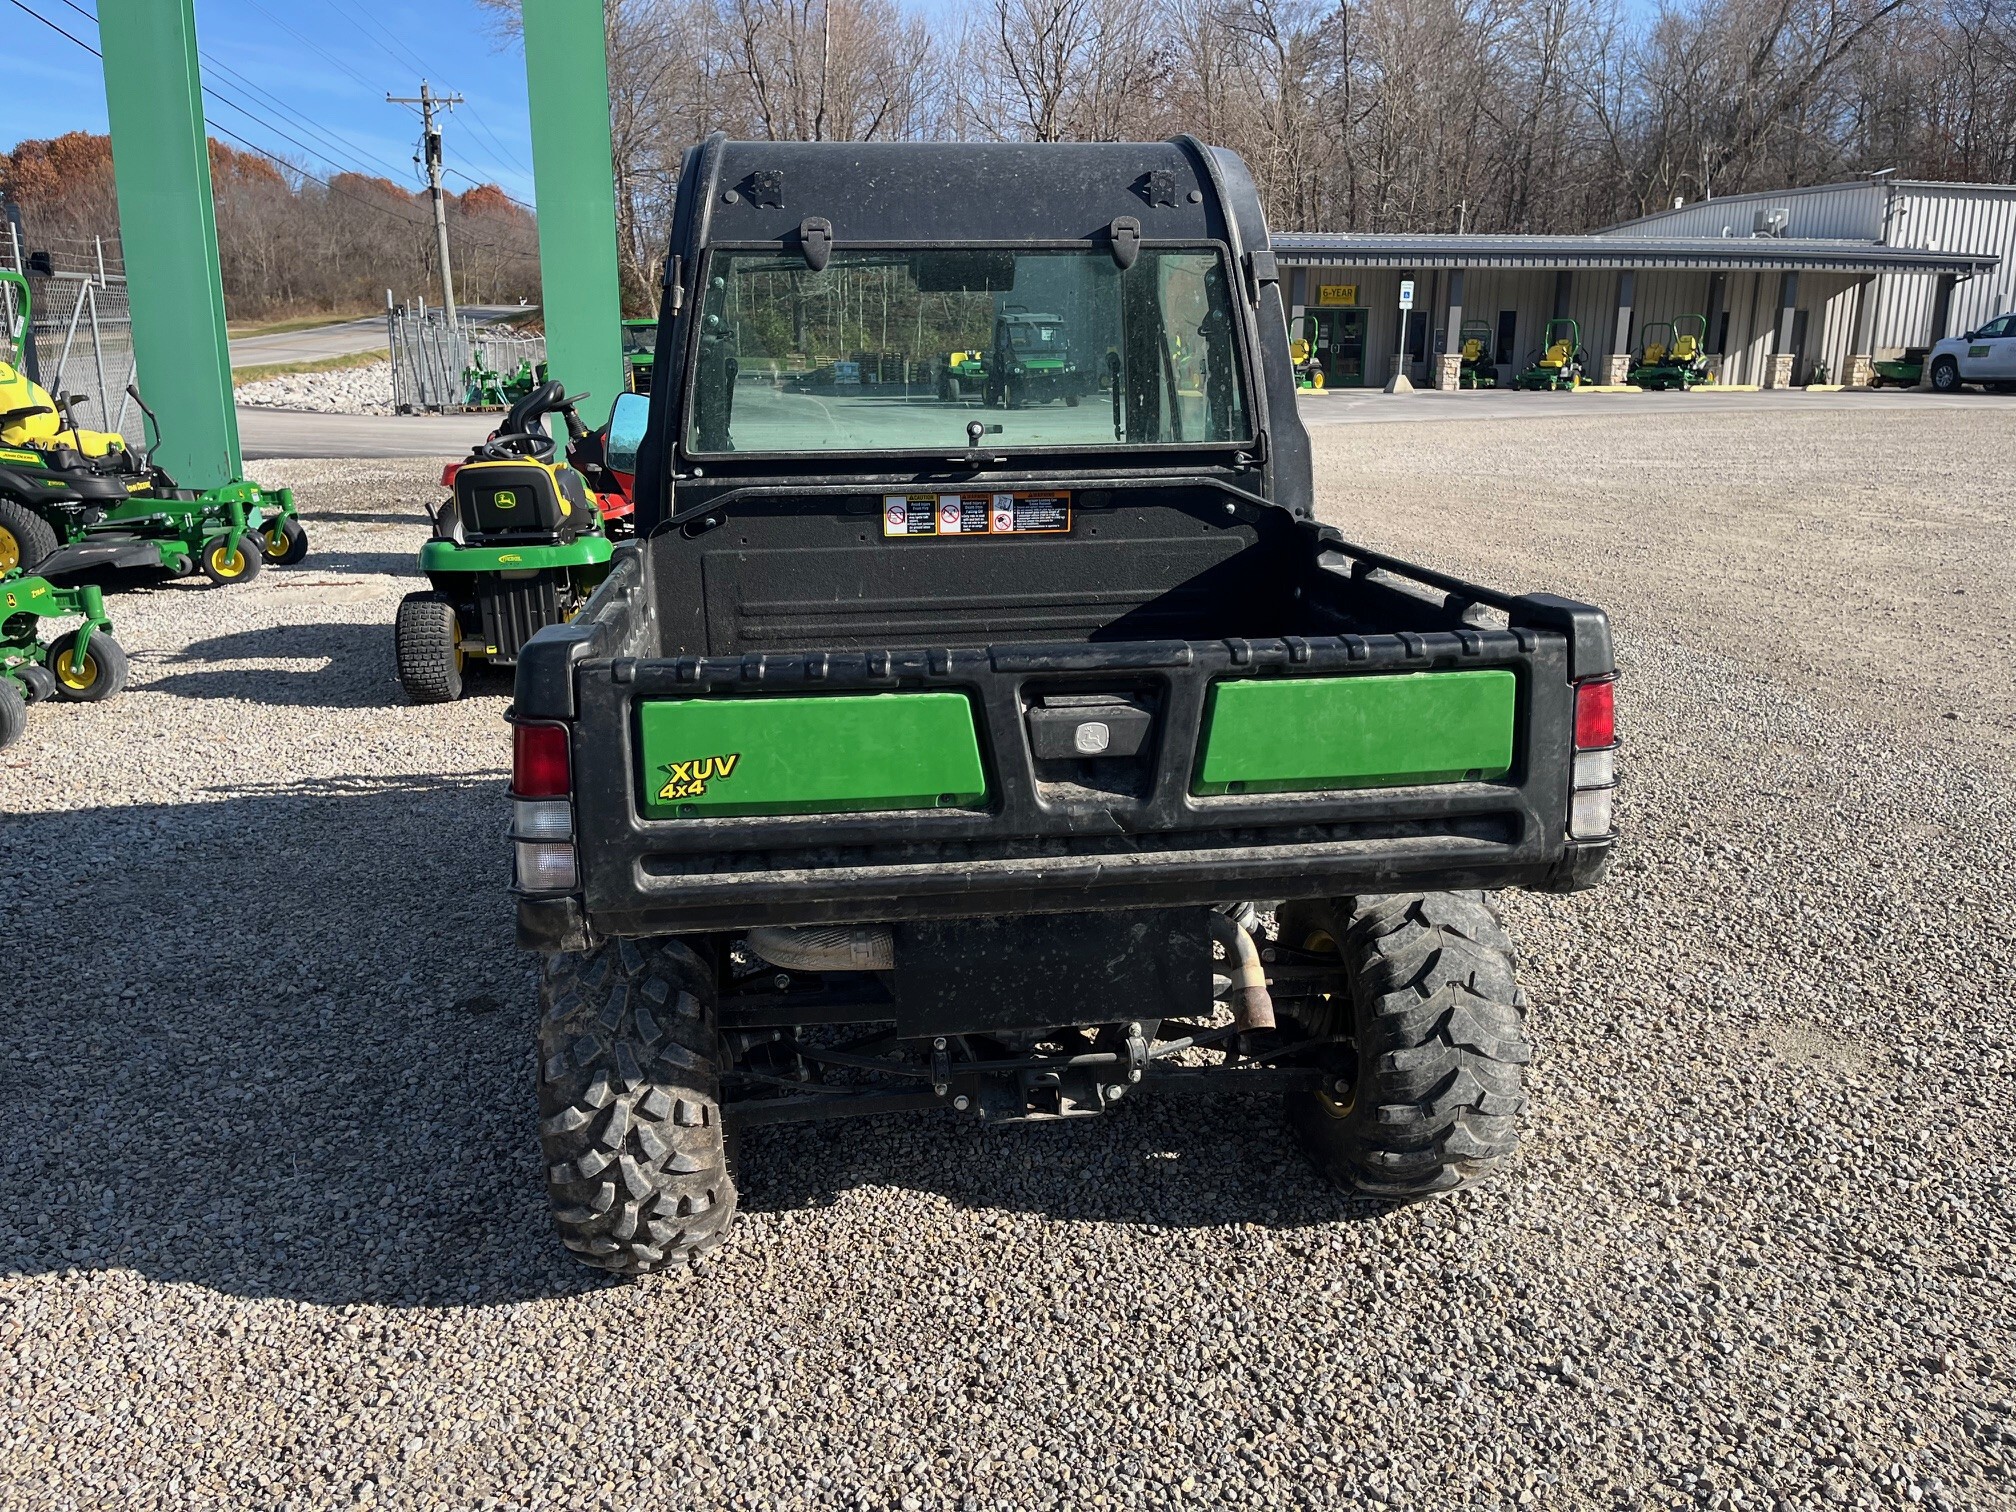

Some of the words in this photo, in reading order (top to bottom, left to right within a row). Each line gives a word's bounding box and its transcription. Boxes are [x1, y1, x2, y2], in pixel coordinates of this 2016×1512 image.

[1322, 288, 1353, 298] 6-YEAR
[668, 754, 739, 784] XUV
[659, 779, 705, 799] 4x4
